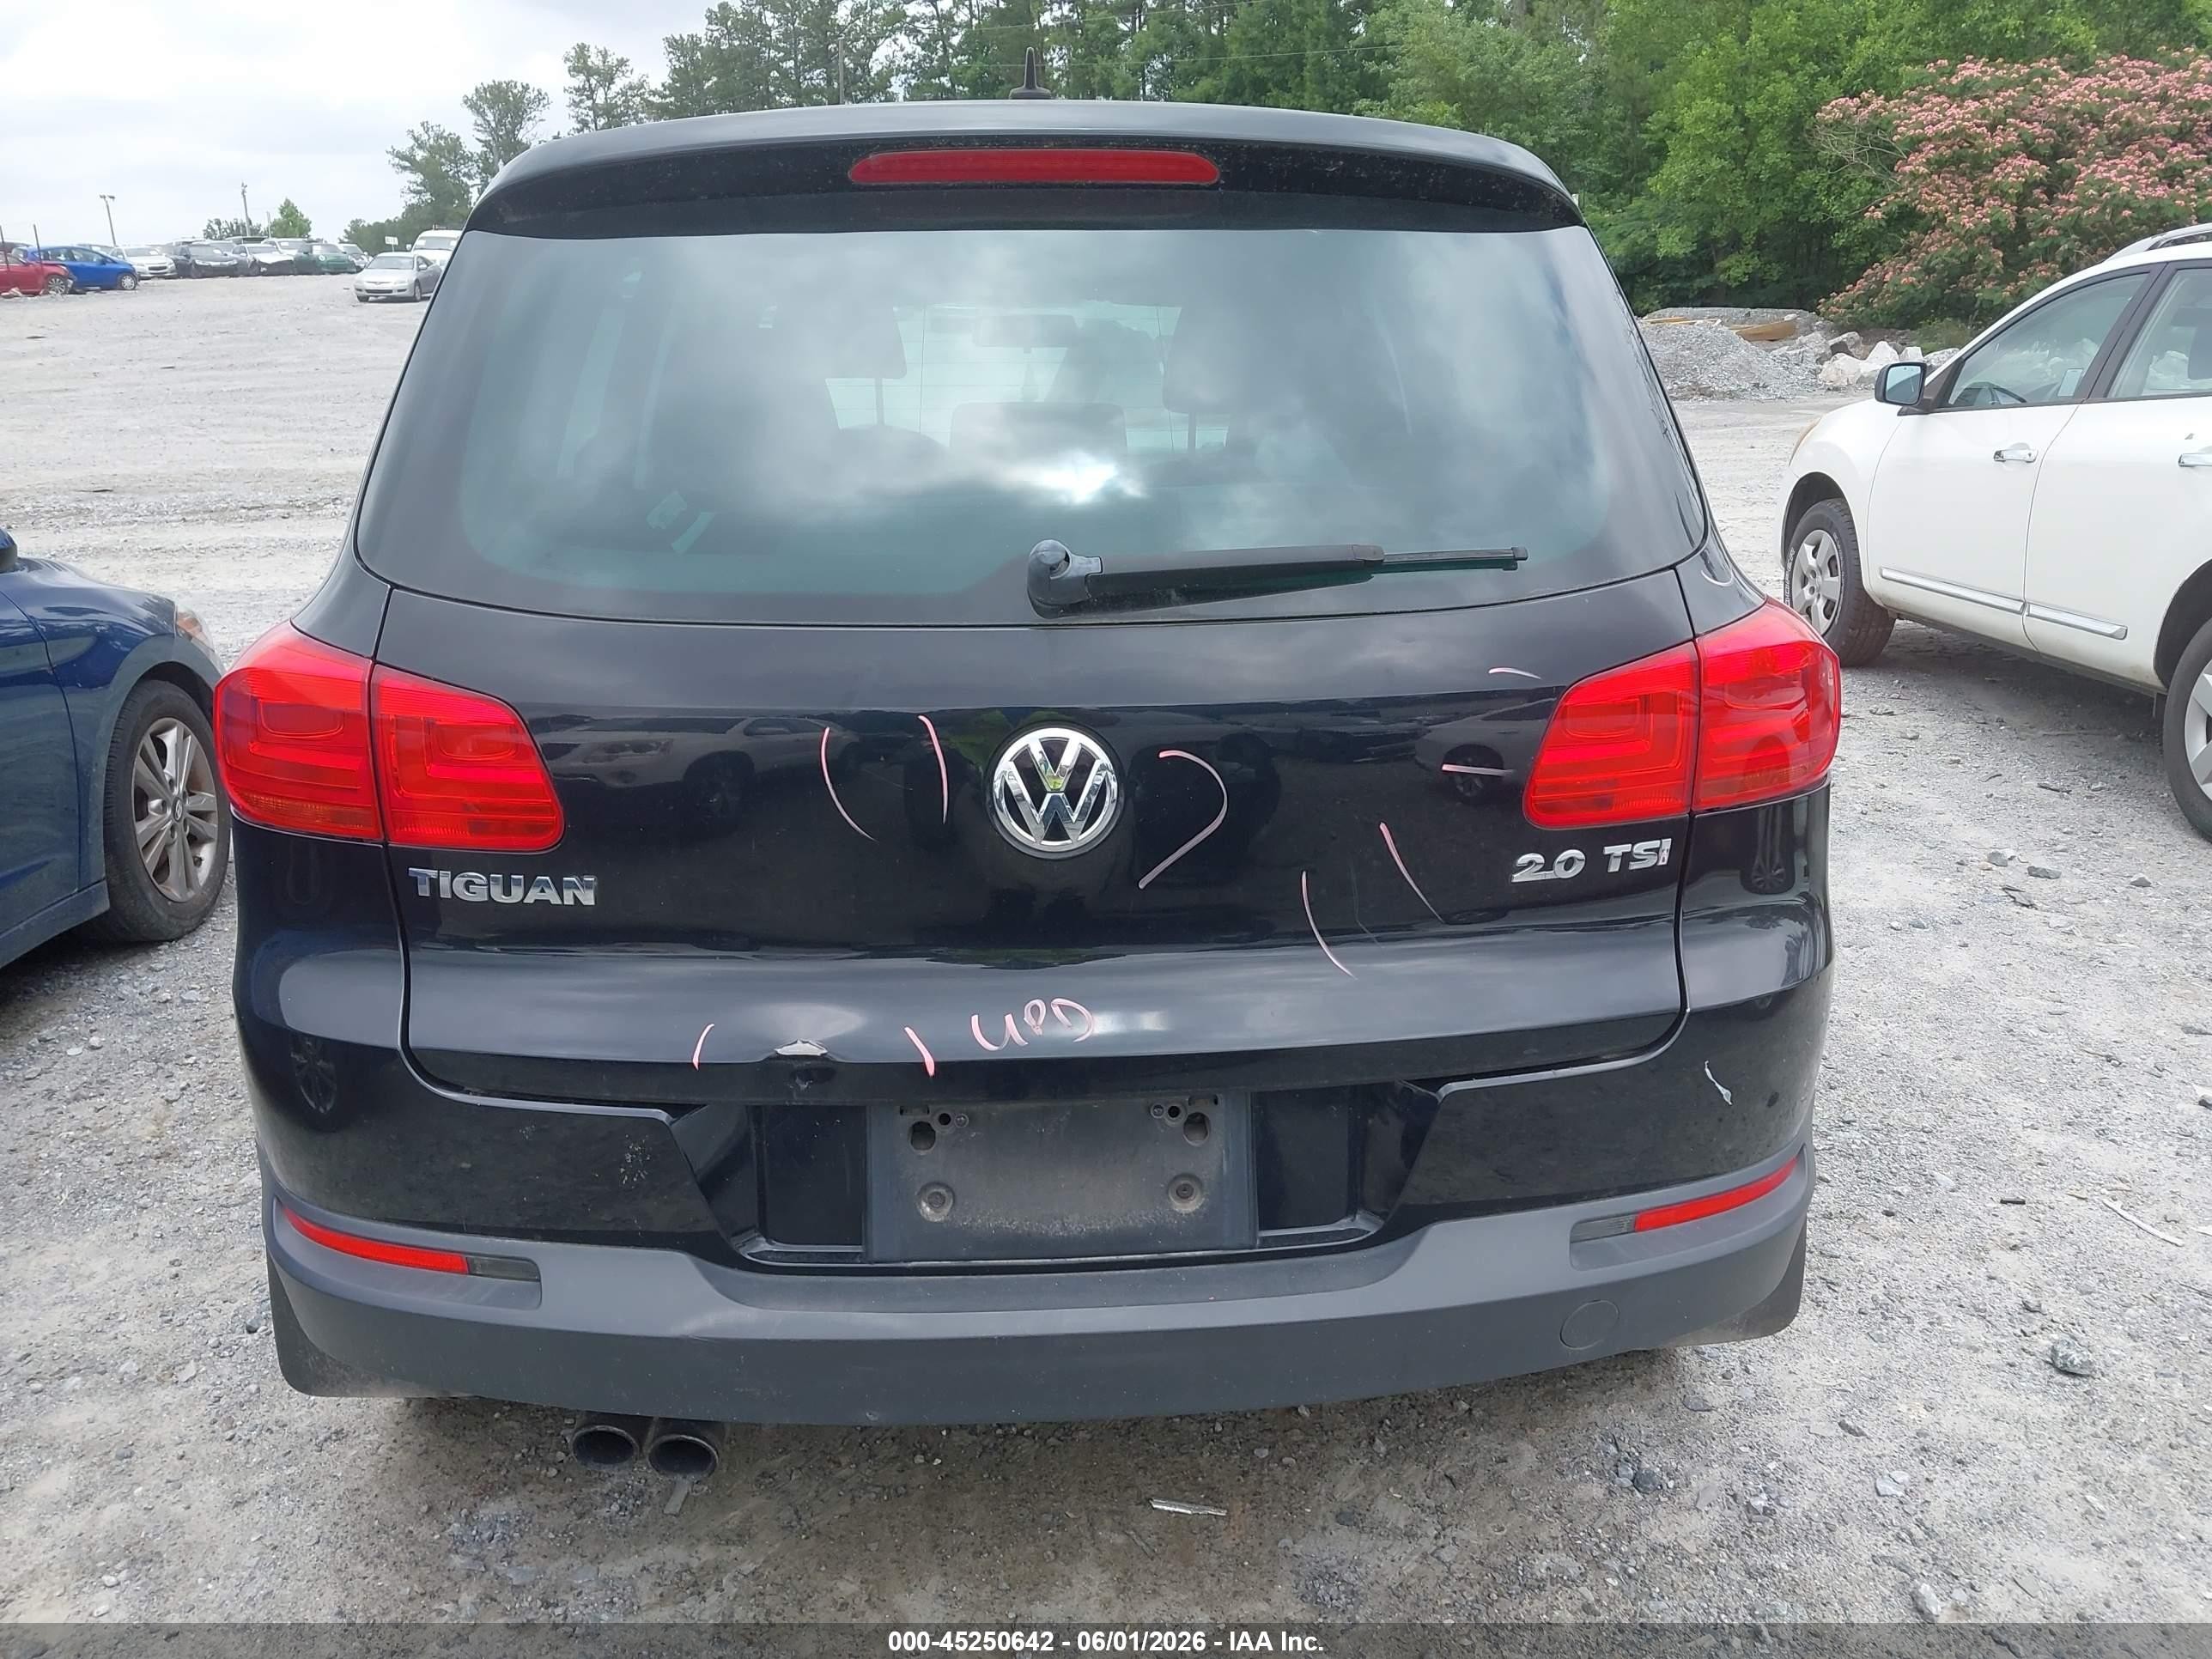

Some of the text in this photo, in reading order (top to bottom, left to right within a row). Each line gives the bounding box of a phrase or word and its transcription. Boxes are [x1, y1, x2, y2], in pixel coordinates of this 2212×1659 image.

[993, 727, 1118, 852] VW
[1603, 837, 1672, 873] TSI
[408, 866, 597, 906] TIGUAN
